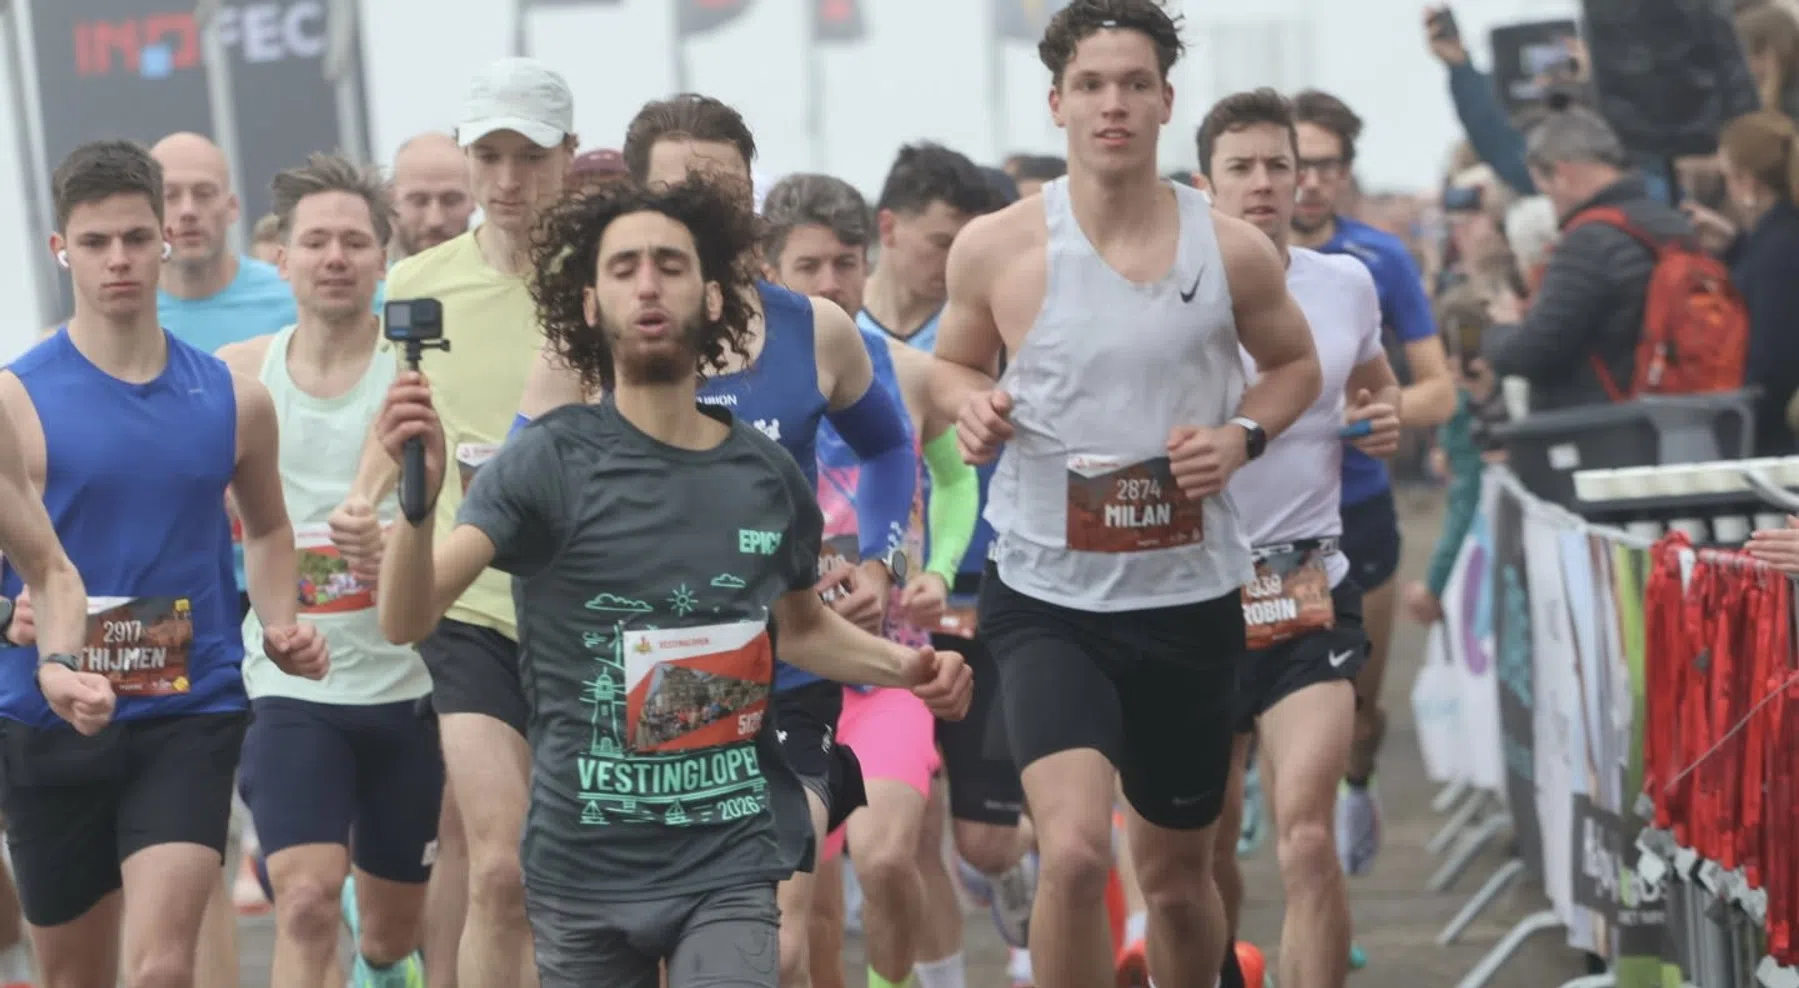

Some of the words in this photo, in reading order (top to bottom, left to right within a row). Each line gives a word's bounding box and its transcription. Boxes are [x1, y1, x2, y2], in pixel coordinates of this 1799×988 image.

[1116, 478, 1161, 501] 2874
[1104, 502, 1171, 528] MILAN
[103, 620, 142, 643] 2917
[577, 746, 761, 793] VESTINGLOPE
[717, 797, 761, 821] 2026
